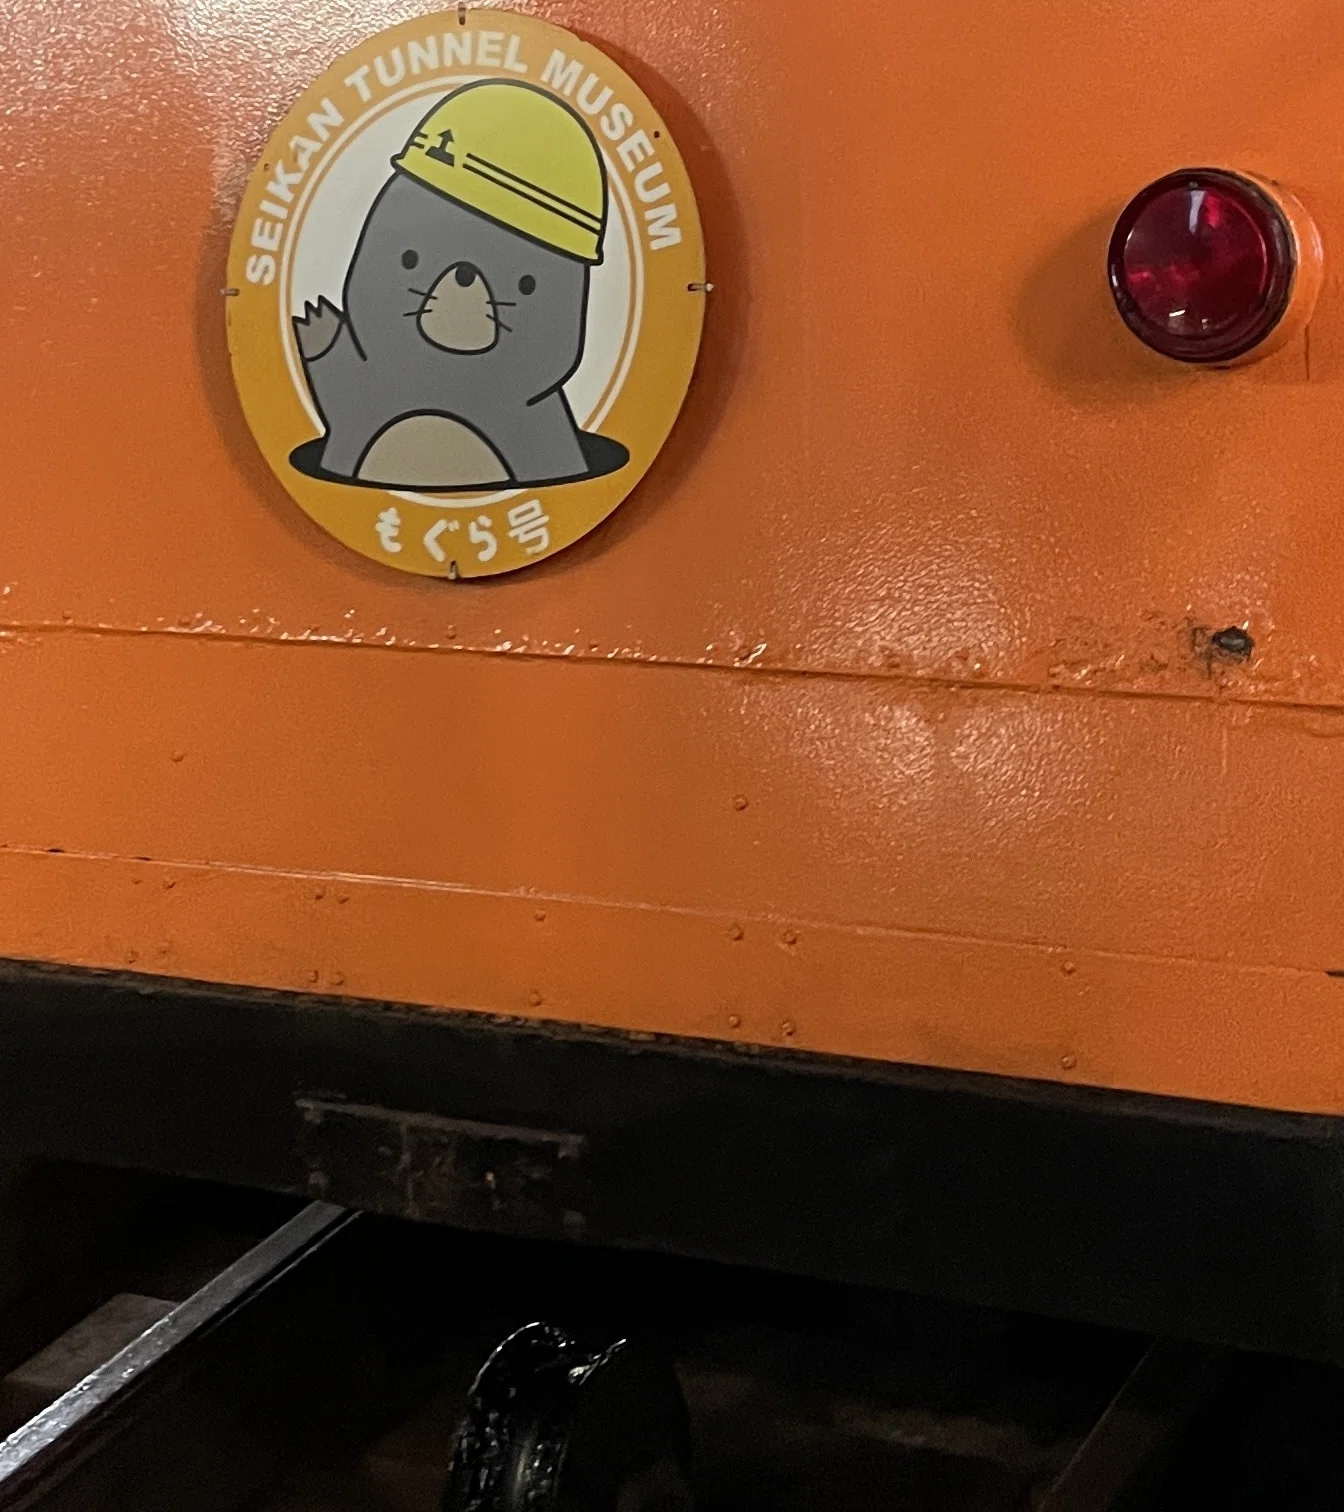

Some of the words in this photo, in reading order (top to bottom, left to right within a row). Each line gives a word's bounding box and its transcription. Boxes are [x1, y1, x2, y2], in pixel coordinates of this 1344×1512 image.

[247, 100, 343, 286] SEIKAN
[345, 31, 529, 101] TUNNEL
[541, 49, 682, 250] MUSEUM
[375, 499, 550, 562] もぐら号
